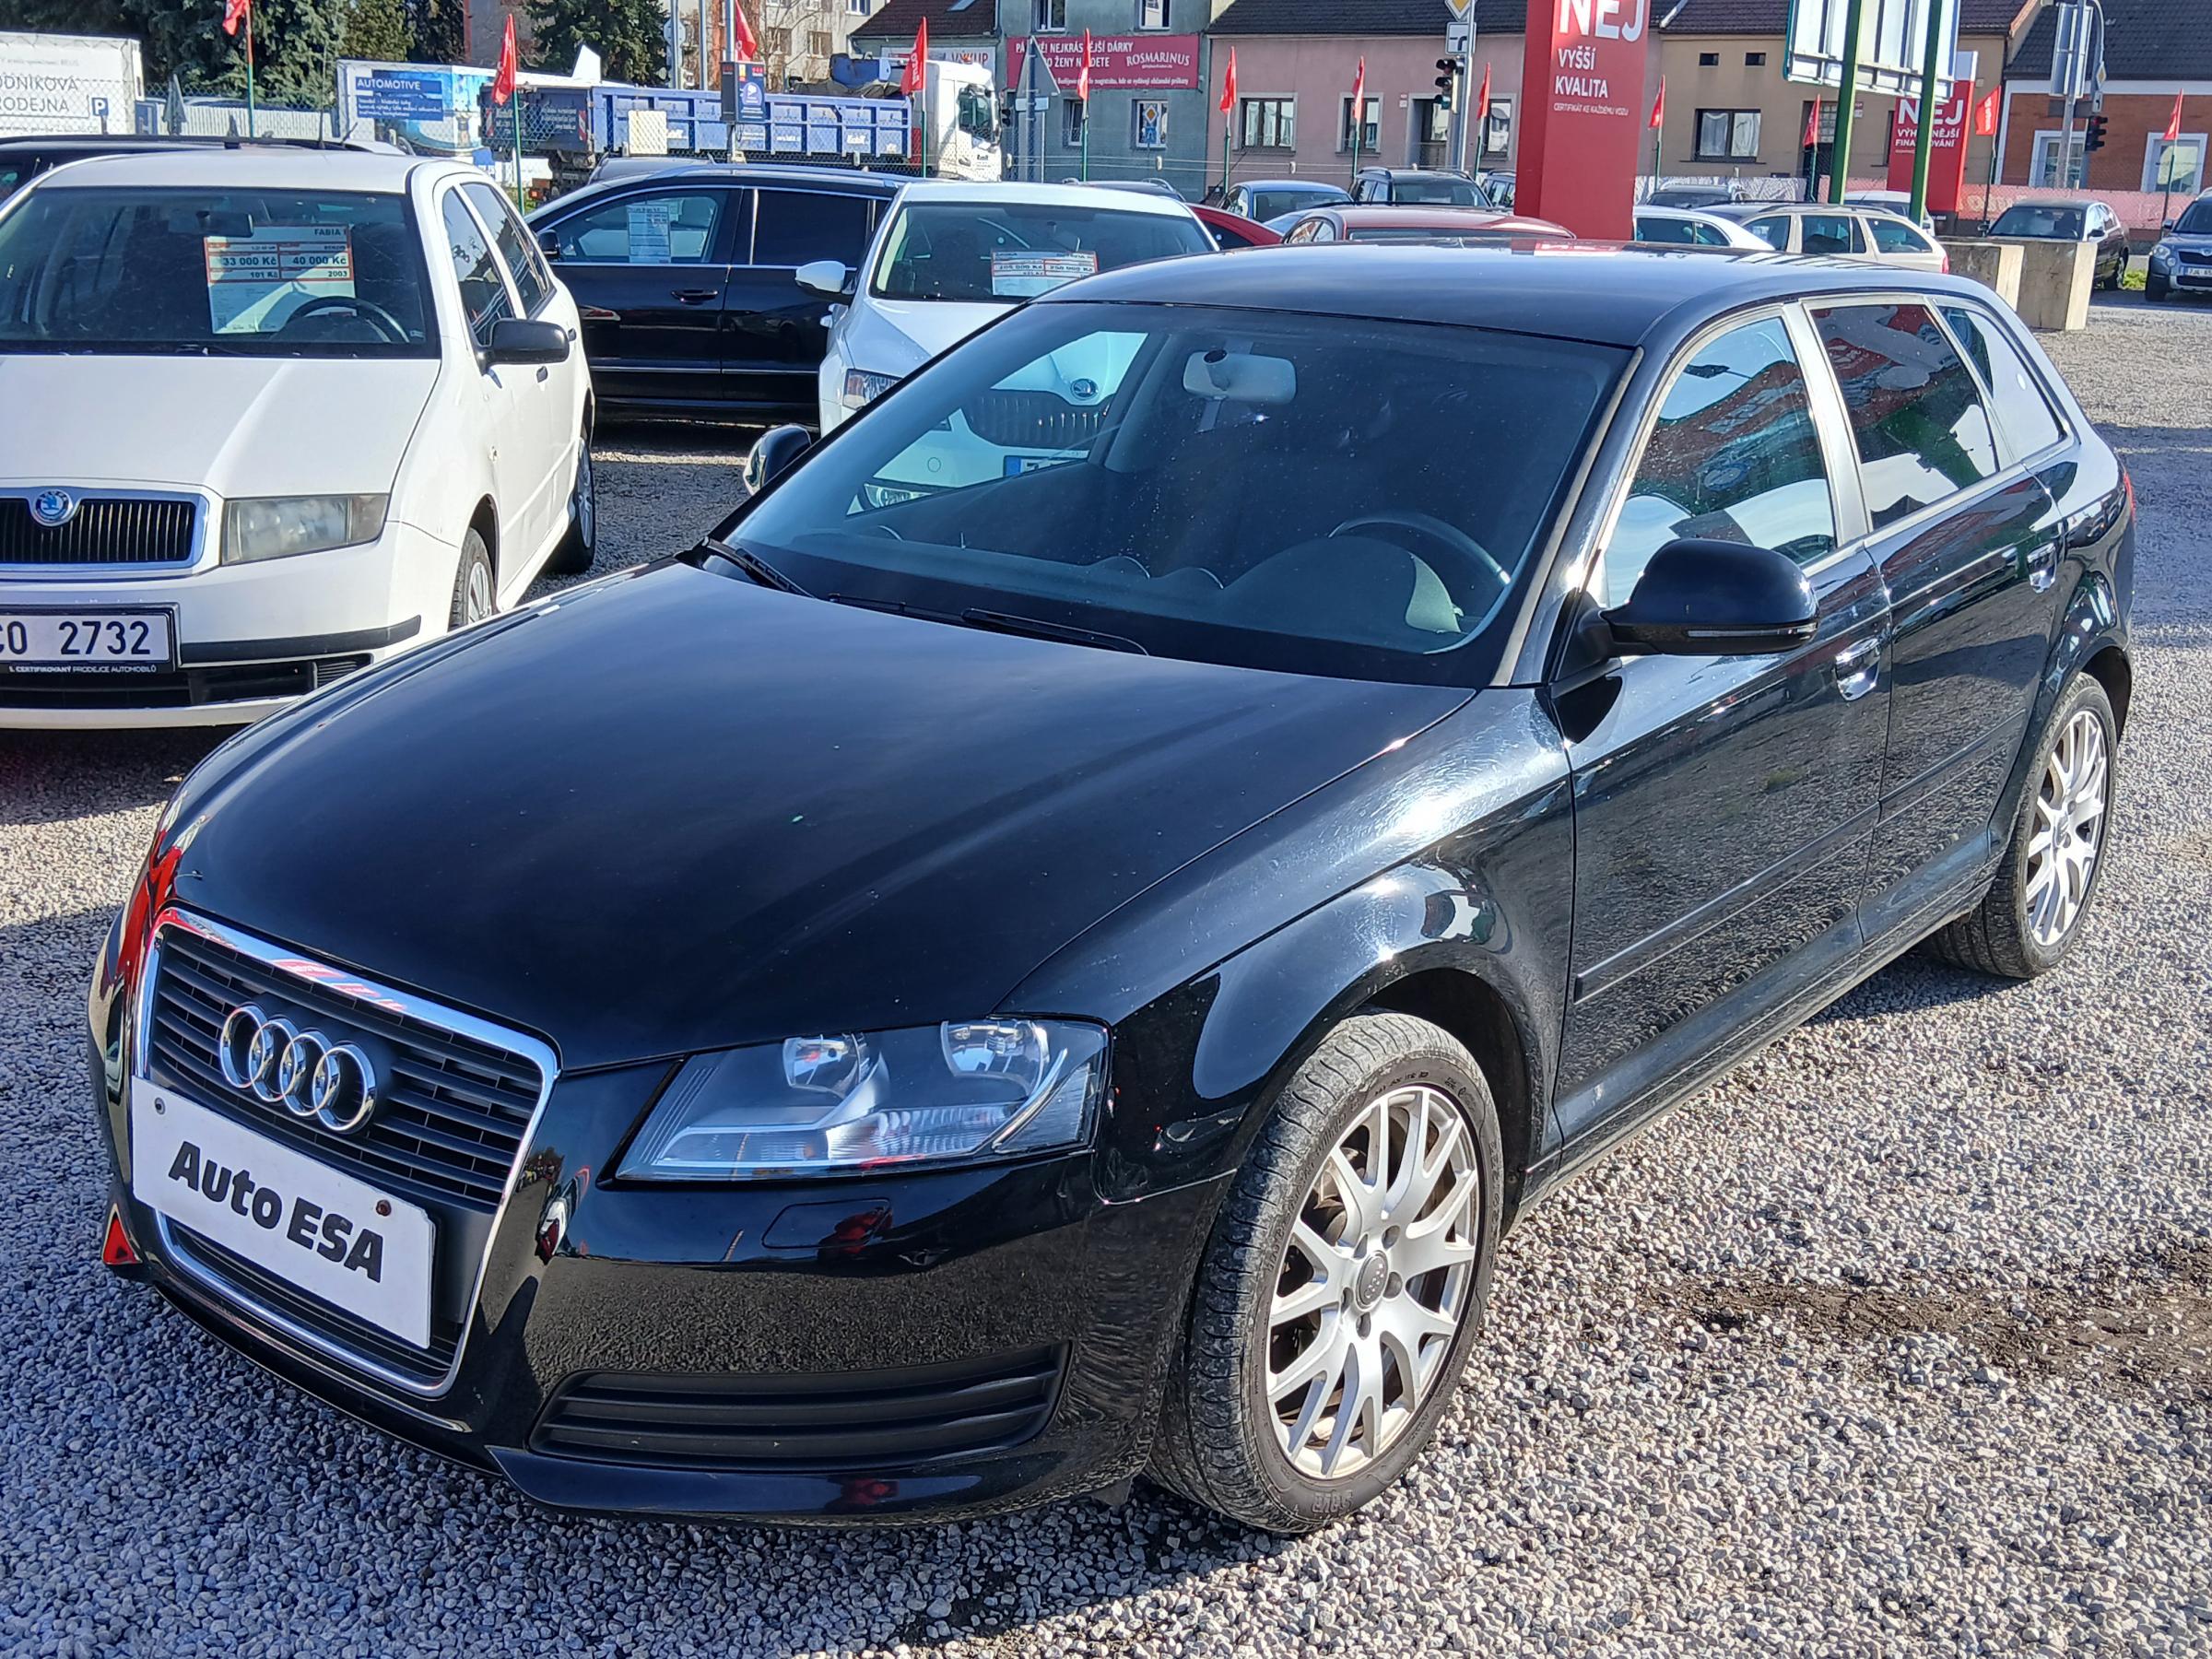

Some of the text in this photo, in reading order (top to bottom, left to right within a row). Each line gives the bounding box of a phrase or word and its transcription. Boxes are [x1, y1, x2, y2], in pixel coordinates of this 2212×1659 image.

[1559, 0, 1644, 41] NEJ
[1050, 41, 1106, 53] NEJKRÁSĚJŠÍ
[1107, 41, 1134, 53] DÁRKY
[1054, 56, 1077, 67] ŽENY
[1126, 52, 1190, 66] ROSMARINUS
[1558, 45, 1596, 70] VYŠŠÍ
[0, 74, 78, 91] DNIKOVÁ
[357, 78, 421, 90] AUTOMOTIVE
[1555, 76, 1608, 98] KVALITA
[1898, 127, 1960, 138] VÝHNĚJŠÍ
[223, 255, 276, 266] 33 000 Kč
[292, 257, 308, 265] 40
[332, 255, 347, 265] Kč
[0, 620, 150, 655] 0 2732
[168, 1140, 383, 1284] Auto ESA
